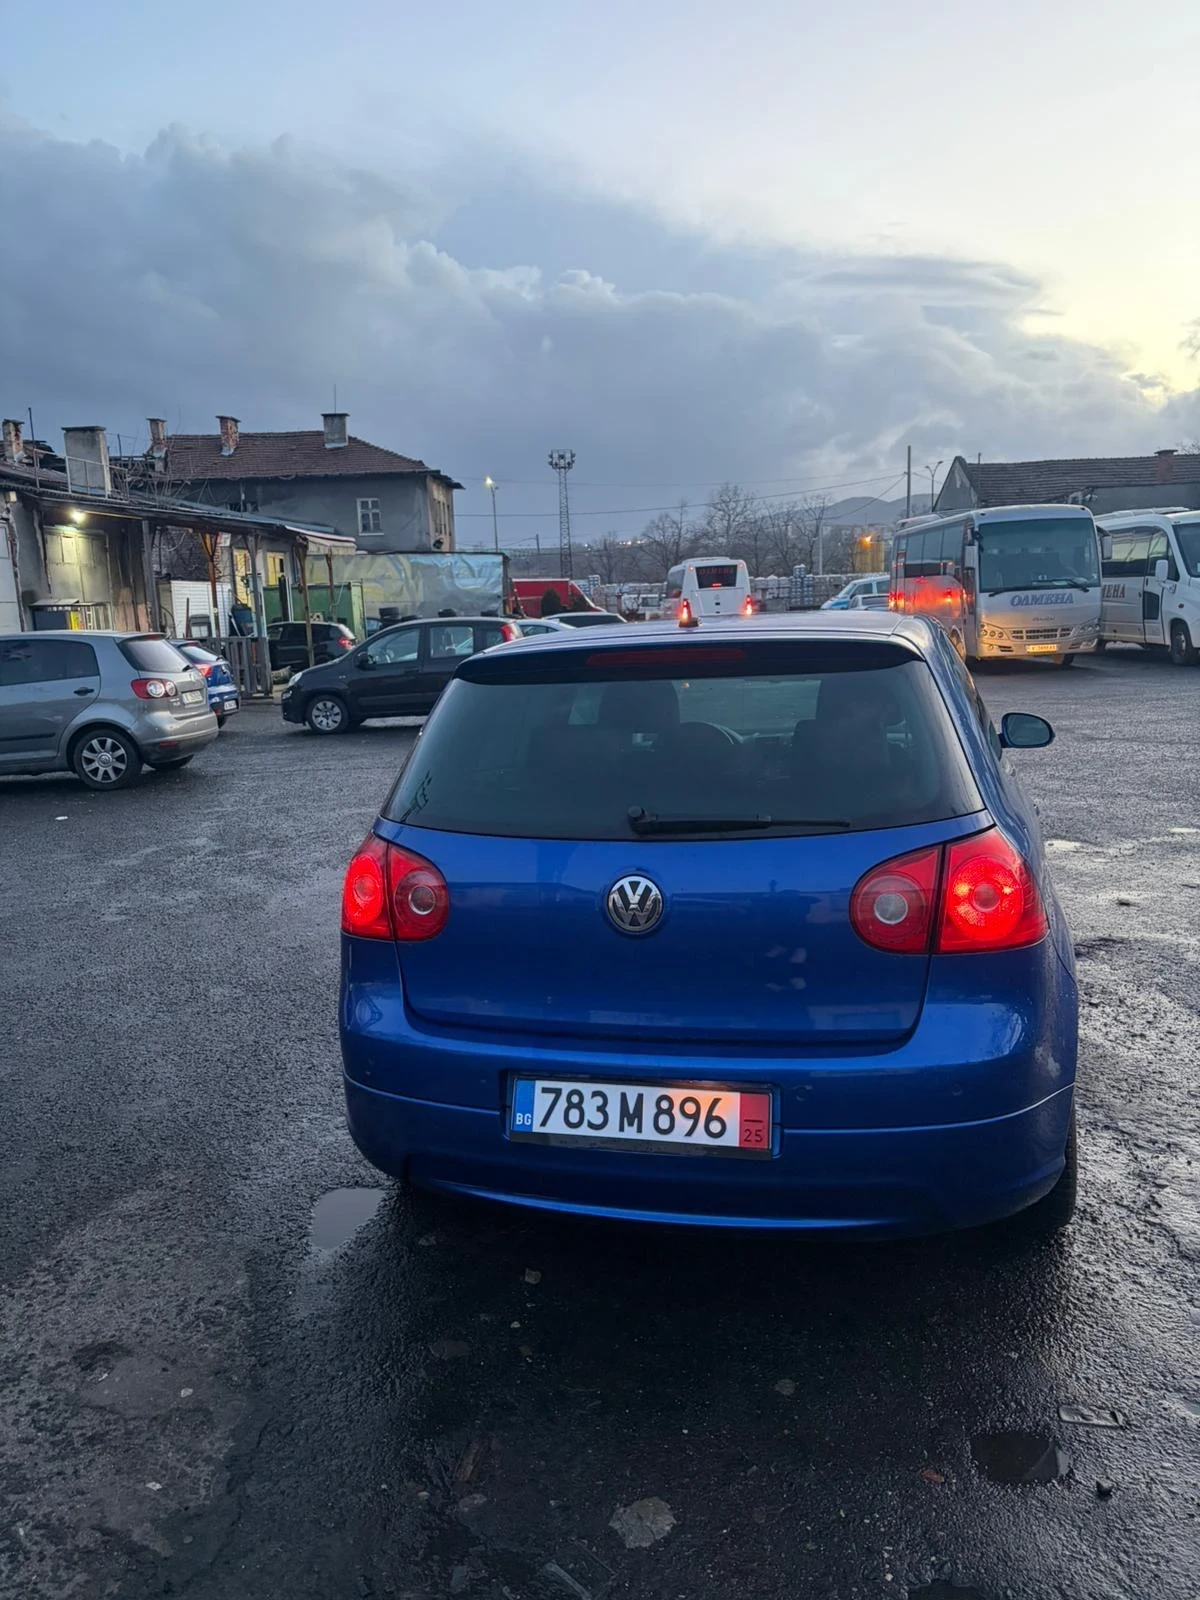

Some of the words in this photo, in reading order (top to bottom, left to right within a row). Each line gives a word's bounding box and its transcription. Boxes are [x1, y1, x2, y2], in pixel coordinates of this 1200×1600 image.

[515, 1112, 532, 1126] BG
[539, 1087, 609, 1131] 783
[618, 1091, 644, 1134] M
[653, 1094, 727, 1139] 896
[743, 1128, 764, 1143] 25
